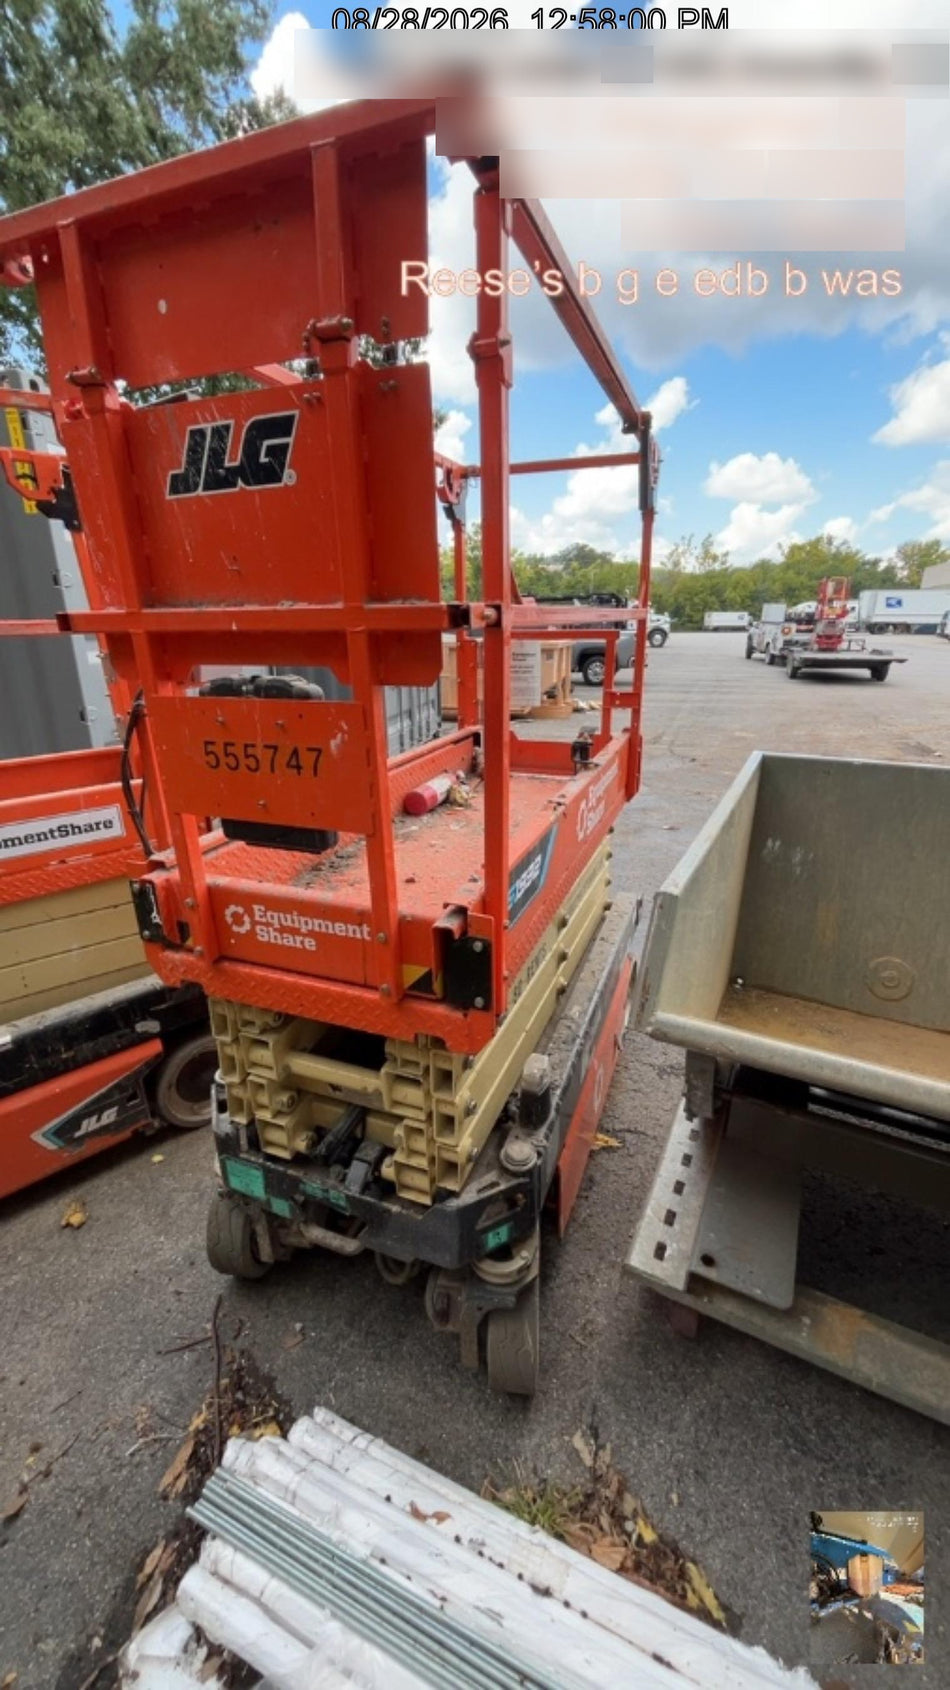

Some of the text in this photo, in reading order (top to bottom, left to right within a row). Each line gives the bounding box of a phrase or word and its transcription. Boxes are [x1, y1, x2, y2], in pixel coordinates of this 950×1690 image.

[165, 409, 299, 500] JLG
[203, 740, 323, 778] 555747
[0, 818, 114, 850] mentShare
[251, 904, 372, 941] Equipment
[255, 924, 317, 951] Share
[73, 1105, 119, 1139] JLG
